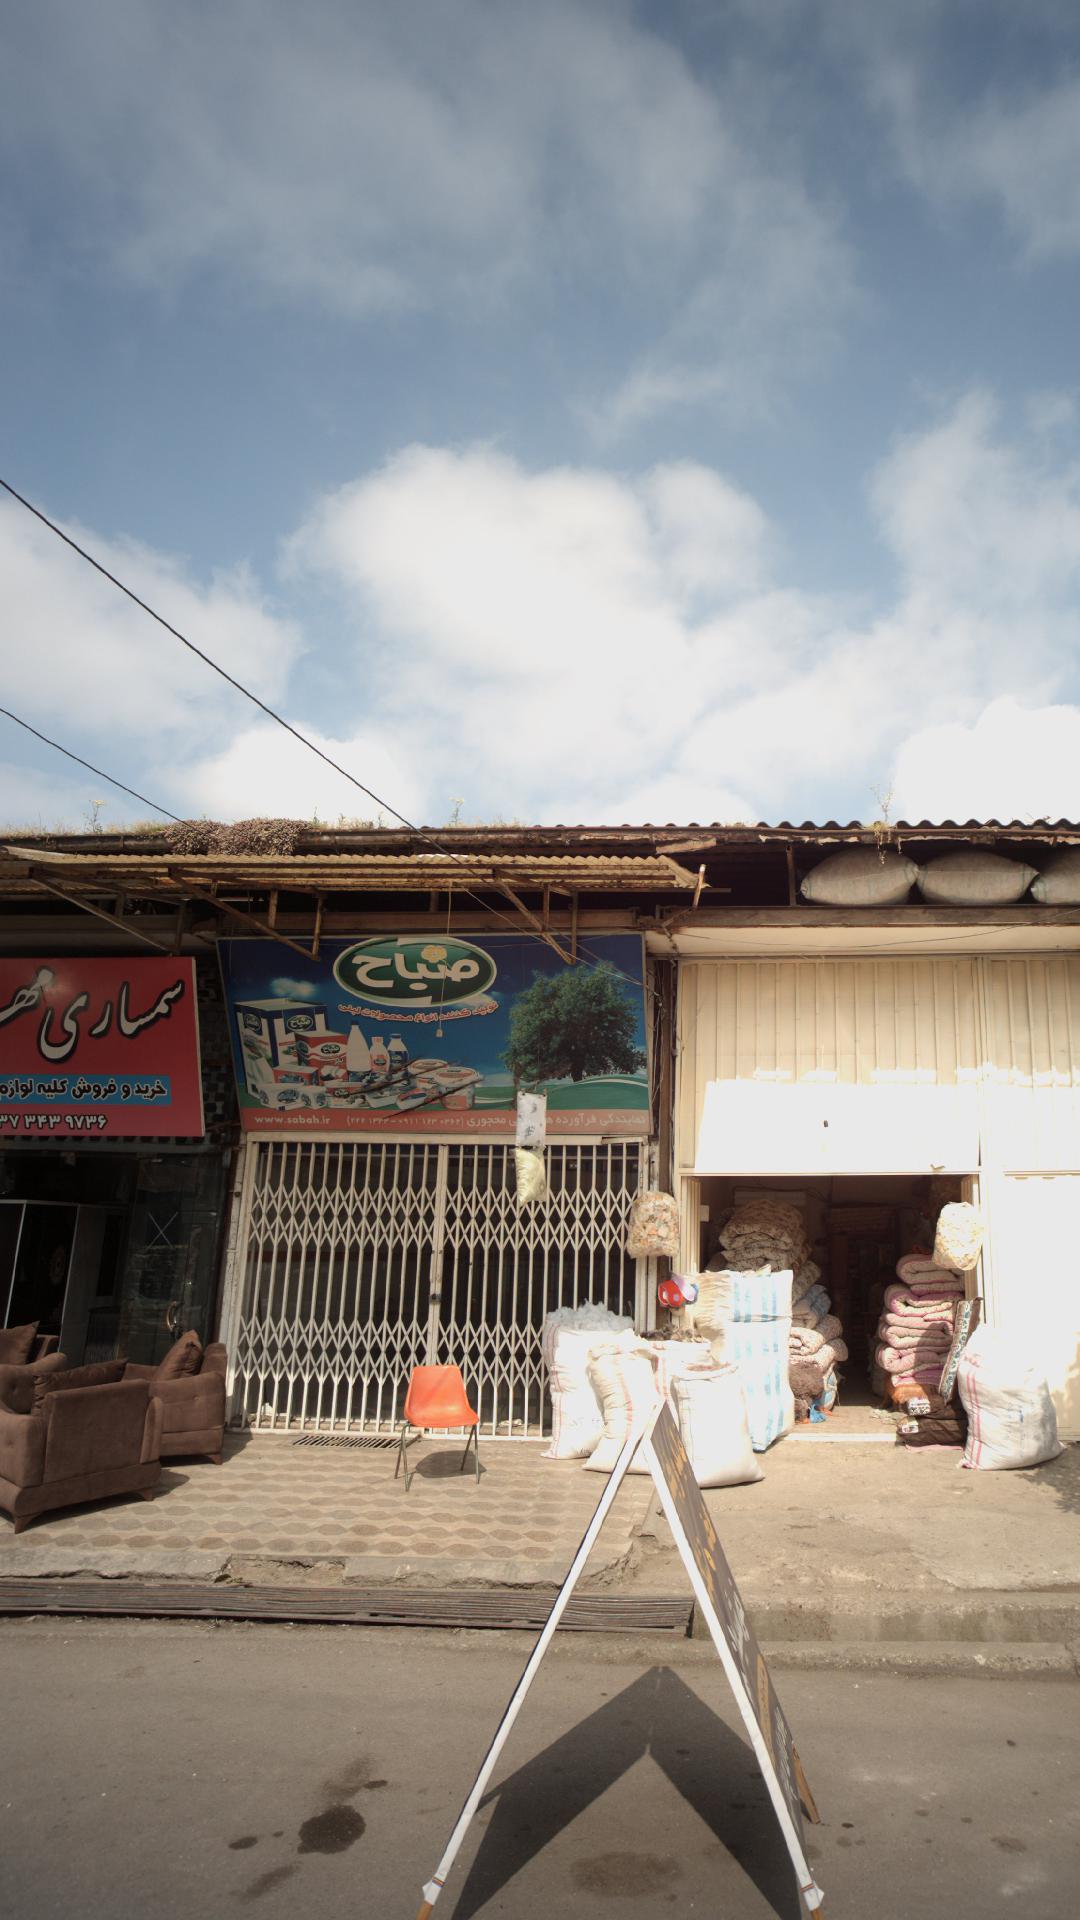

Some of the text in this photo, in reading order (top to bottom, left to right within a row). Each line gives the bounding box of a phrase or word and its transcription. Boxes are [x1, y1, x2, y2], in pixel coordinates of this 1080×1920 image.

[39, 980, 184, 1061] سمساری
[37, 1079, 68, 1099] کلیه
[72, 1077, 117, 1100] فروش
[121, 1083, 132, 1100] و
[135, 1079, 167, 1100] خرید
[24, 1114, 61, 1129] ۳۴۳
[65, 1114, 107, 1129] ۹۷۳۶
[254, 1114, 331, 1125] www.sabah.ir
